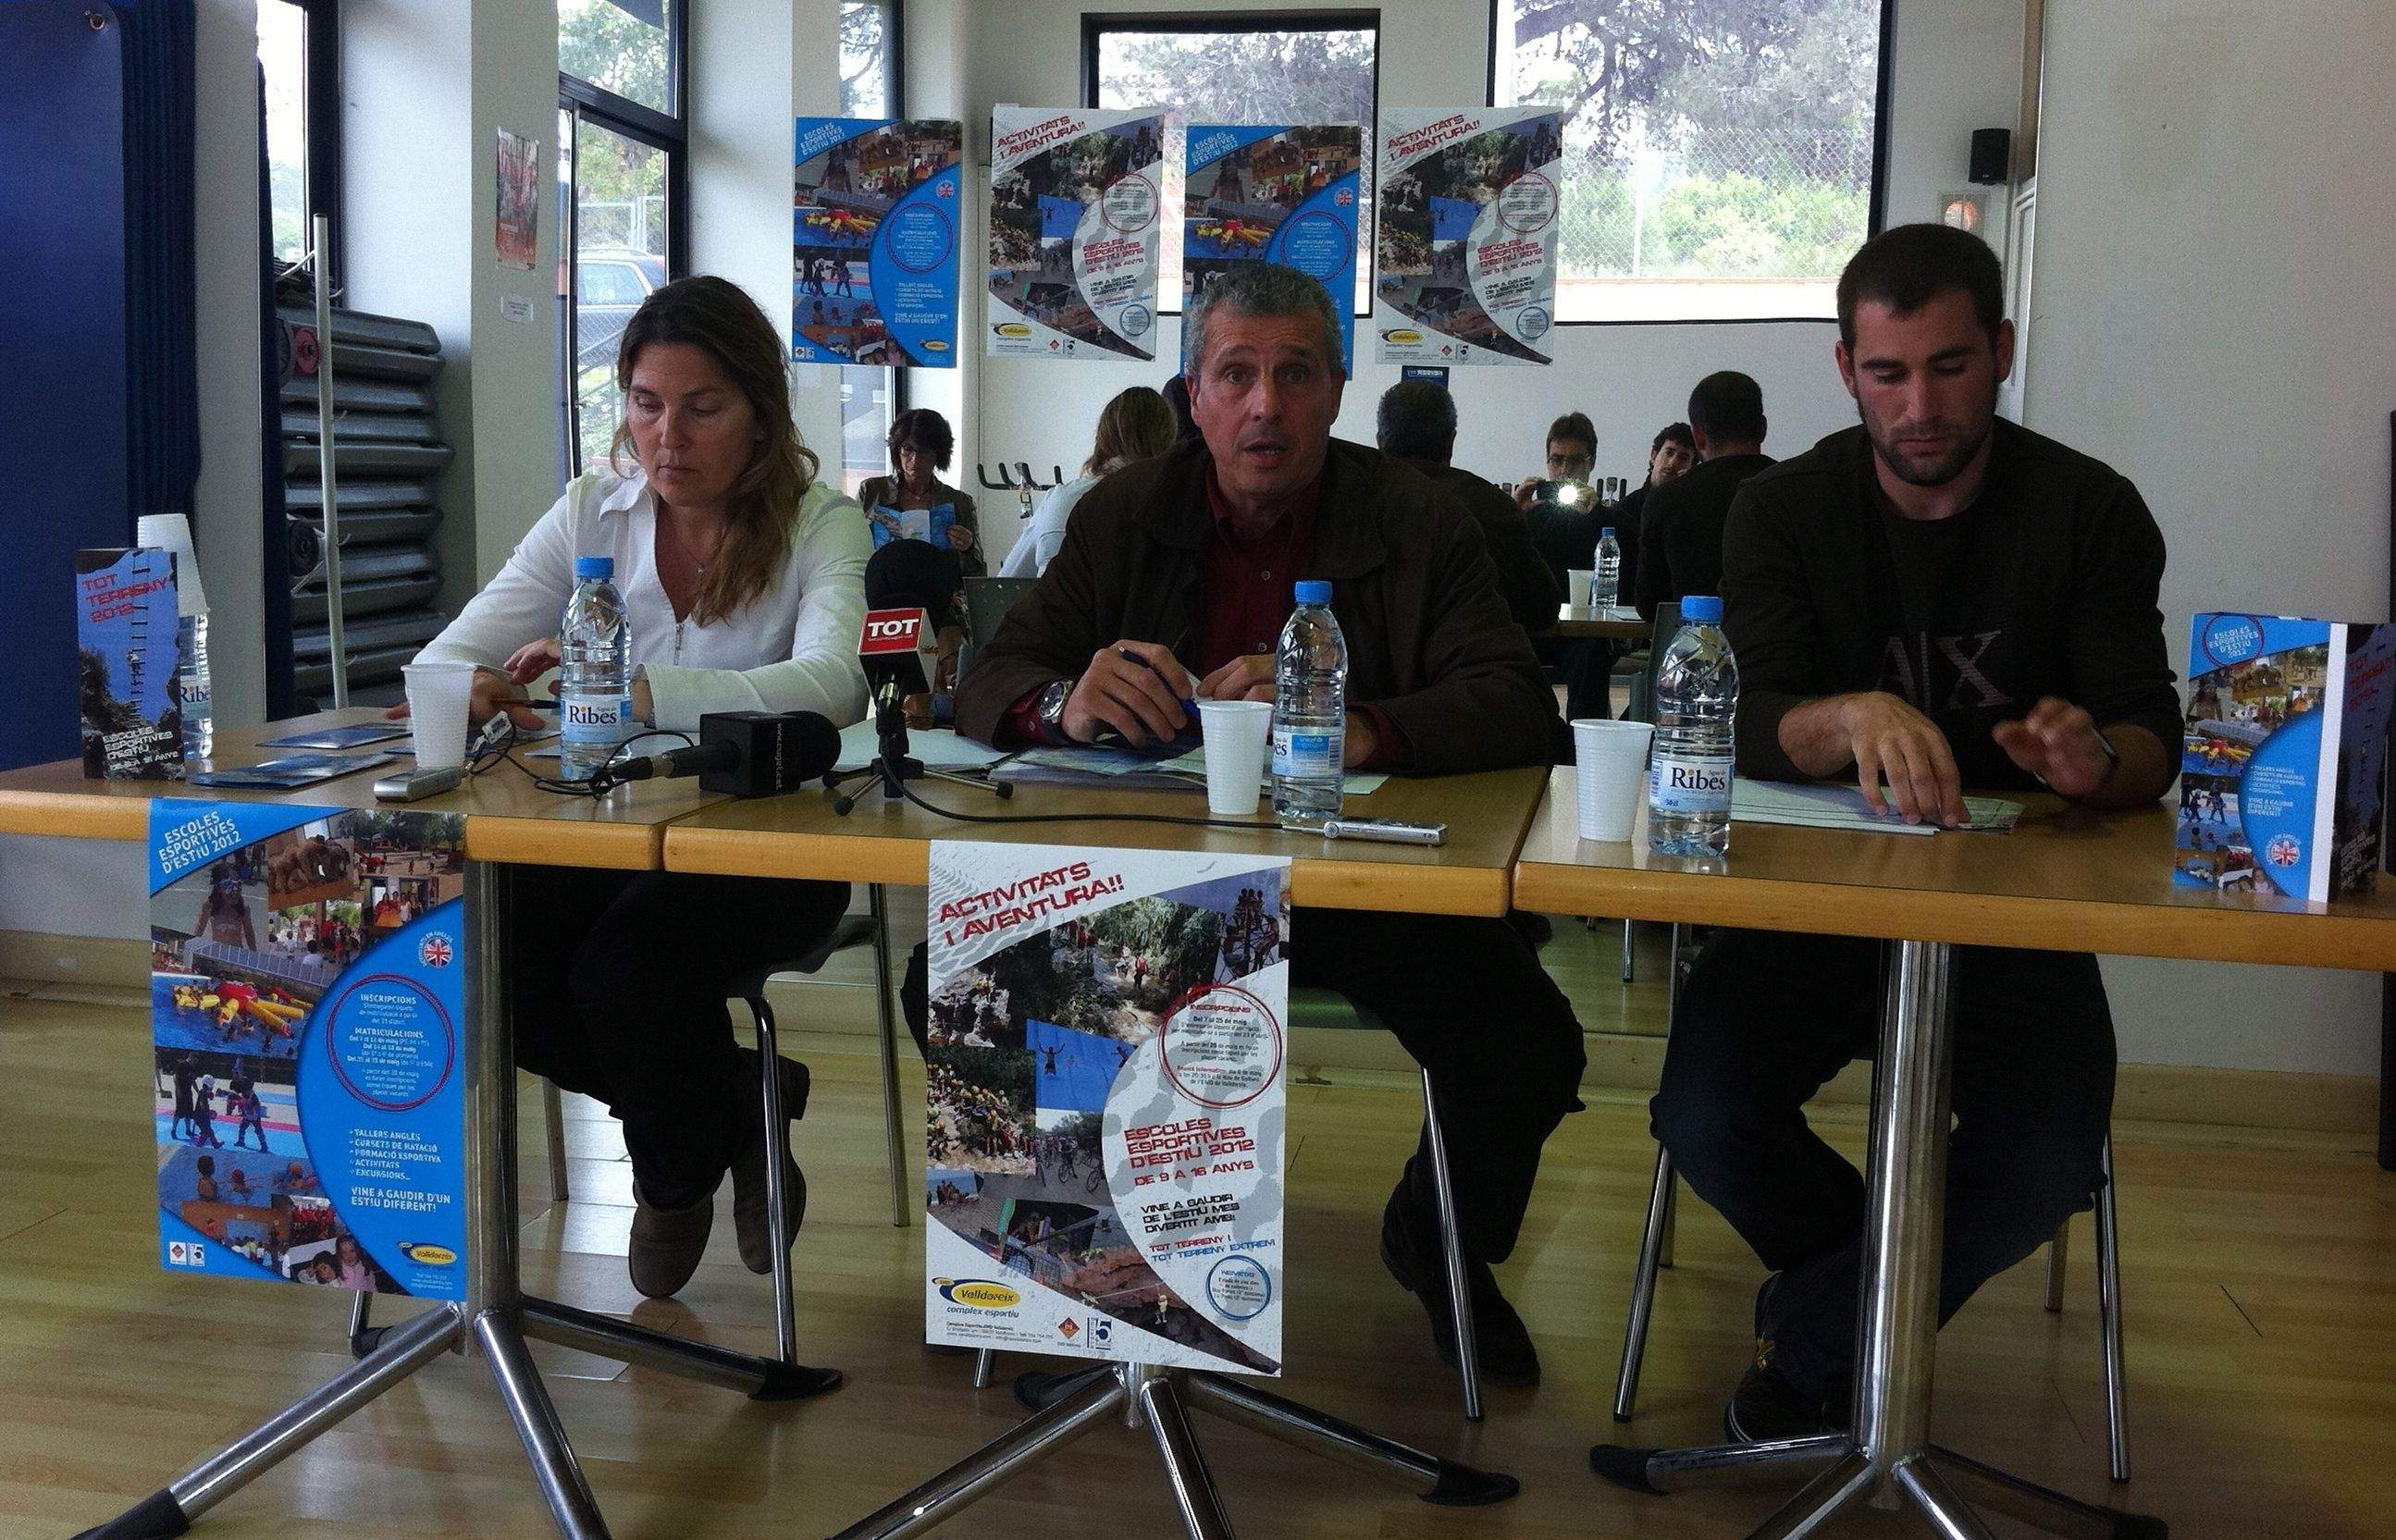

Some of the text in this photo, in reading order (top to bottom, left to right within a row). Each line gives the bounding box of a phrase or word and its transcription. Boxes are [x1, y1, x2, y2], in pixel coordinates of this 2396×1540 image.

[997, 116, 1070, 148] ACTIVITATS
[1388, 115, 1464, 148] ACTIVITATS
[868, 619, 919, 637] TOT
[569, 705, 617, 724] Ribes
[1670, 767, 1725, 790] Ribes
[165, 811, 220, 844] ESCOLES
[159, 819, 235, 861] ESPORTIVES
[162, 831, 241, 874] D'ESTIU 2012
[940, 861, 1091, 923] ACTIVITATS
[945, 874, 1124, 946] I AVENTURA!!
[360, 993, 417, 1004] INSCRIPCIONS
[355, 1027, 424, 1038] MATRICULACIONS
[354, 1129, 389, 1139] TALLERS
[1124, 1117, 1212, 1141] ESCOLES
[354, 1139, 390, 1149] CURSETS
[391, 1141, 402, 1150] DE
[1127, 1127, 1246, 1154] ESPORTIVES
[354, 1149, 441, 1164] FORMACIÓ ESPORTIVA
[355, 1158, 401, 1168] ACTIVITATS
[1130, 1139, 1255, 1169] D'ESTIU 2012
[1134, 1160, 1254, 1186] DE 9 A 16 ANYS
[352, 1187, 451, 1204] VINE A GAUDIR D'UN
[1141, 1193, 1233, 1214] VINE A GAUDIR
[352, 1197, 437, 1214] ESTIU DIFERENT!
[1142, 1214, 1161, 1224] DE
[1164, 1207, 1208, 1221] L'ESTIU
[1145, 1219, 1198, 1234] DIVERTIT
[1149, 1243, 1170, 1252] TOT
[1175, 1235, 1223, 1248] TERRENY
[1152, 1238, 1276, 1263] TOT TERRENY EXTREM
[961, 1289, 1014, 1302] Valldoreix
[946, 1307, 1019, 1318] complex esportiu
